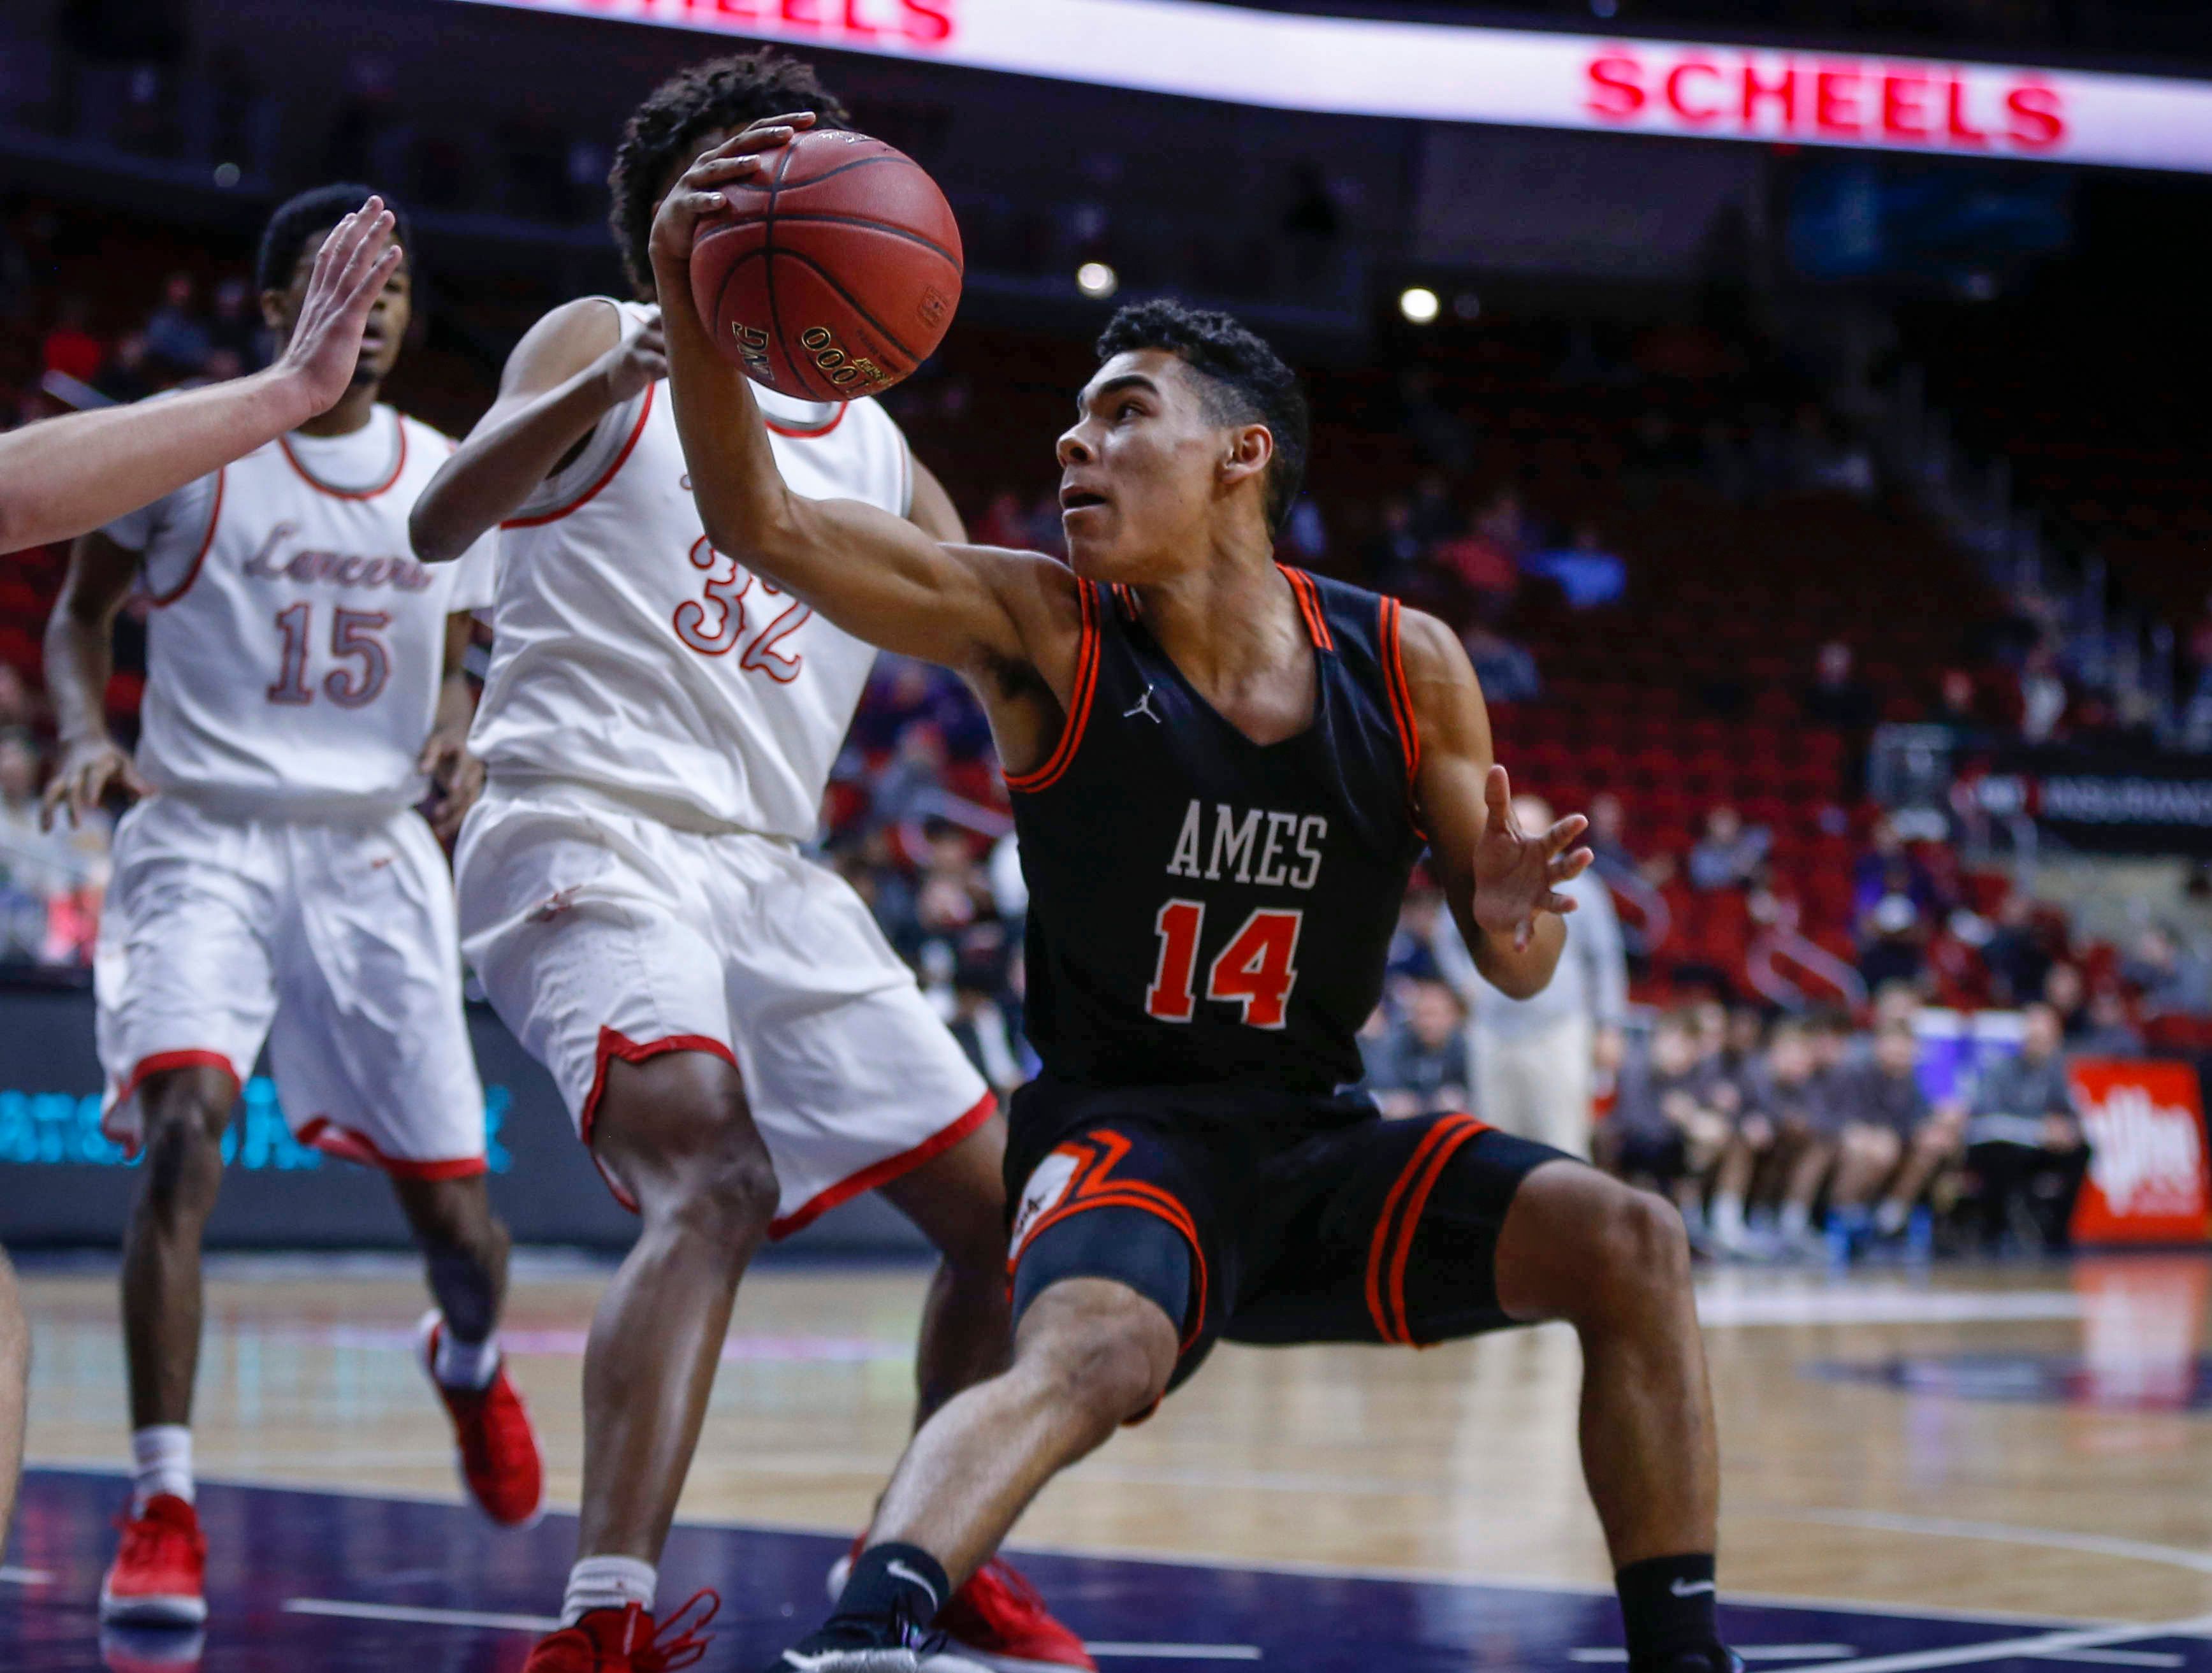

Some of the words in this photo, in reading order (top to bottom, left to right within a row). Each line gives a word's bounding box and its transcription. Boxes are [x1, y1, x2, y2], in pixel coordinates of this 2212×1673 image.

[1586, 48, 2068, 153] SCHEELS
[266, 600, 391, 709] 15
[673, 534, 814, 684] 32
[1166, 799, 1328, 890] AMES
[1145, 897, 1304, 1030] 14
